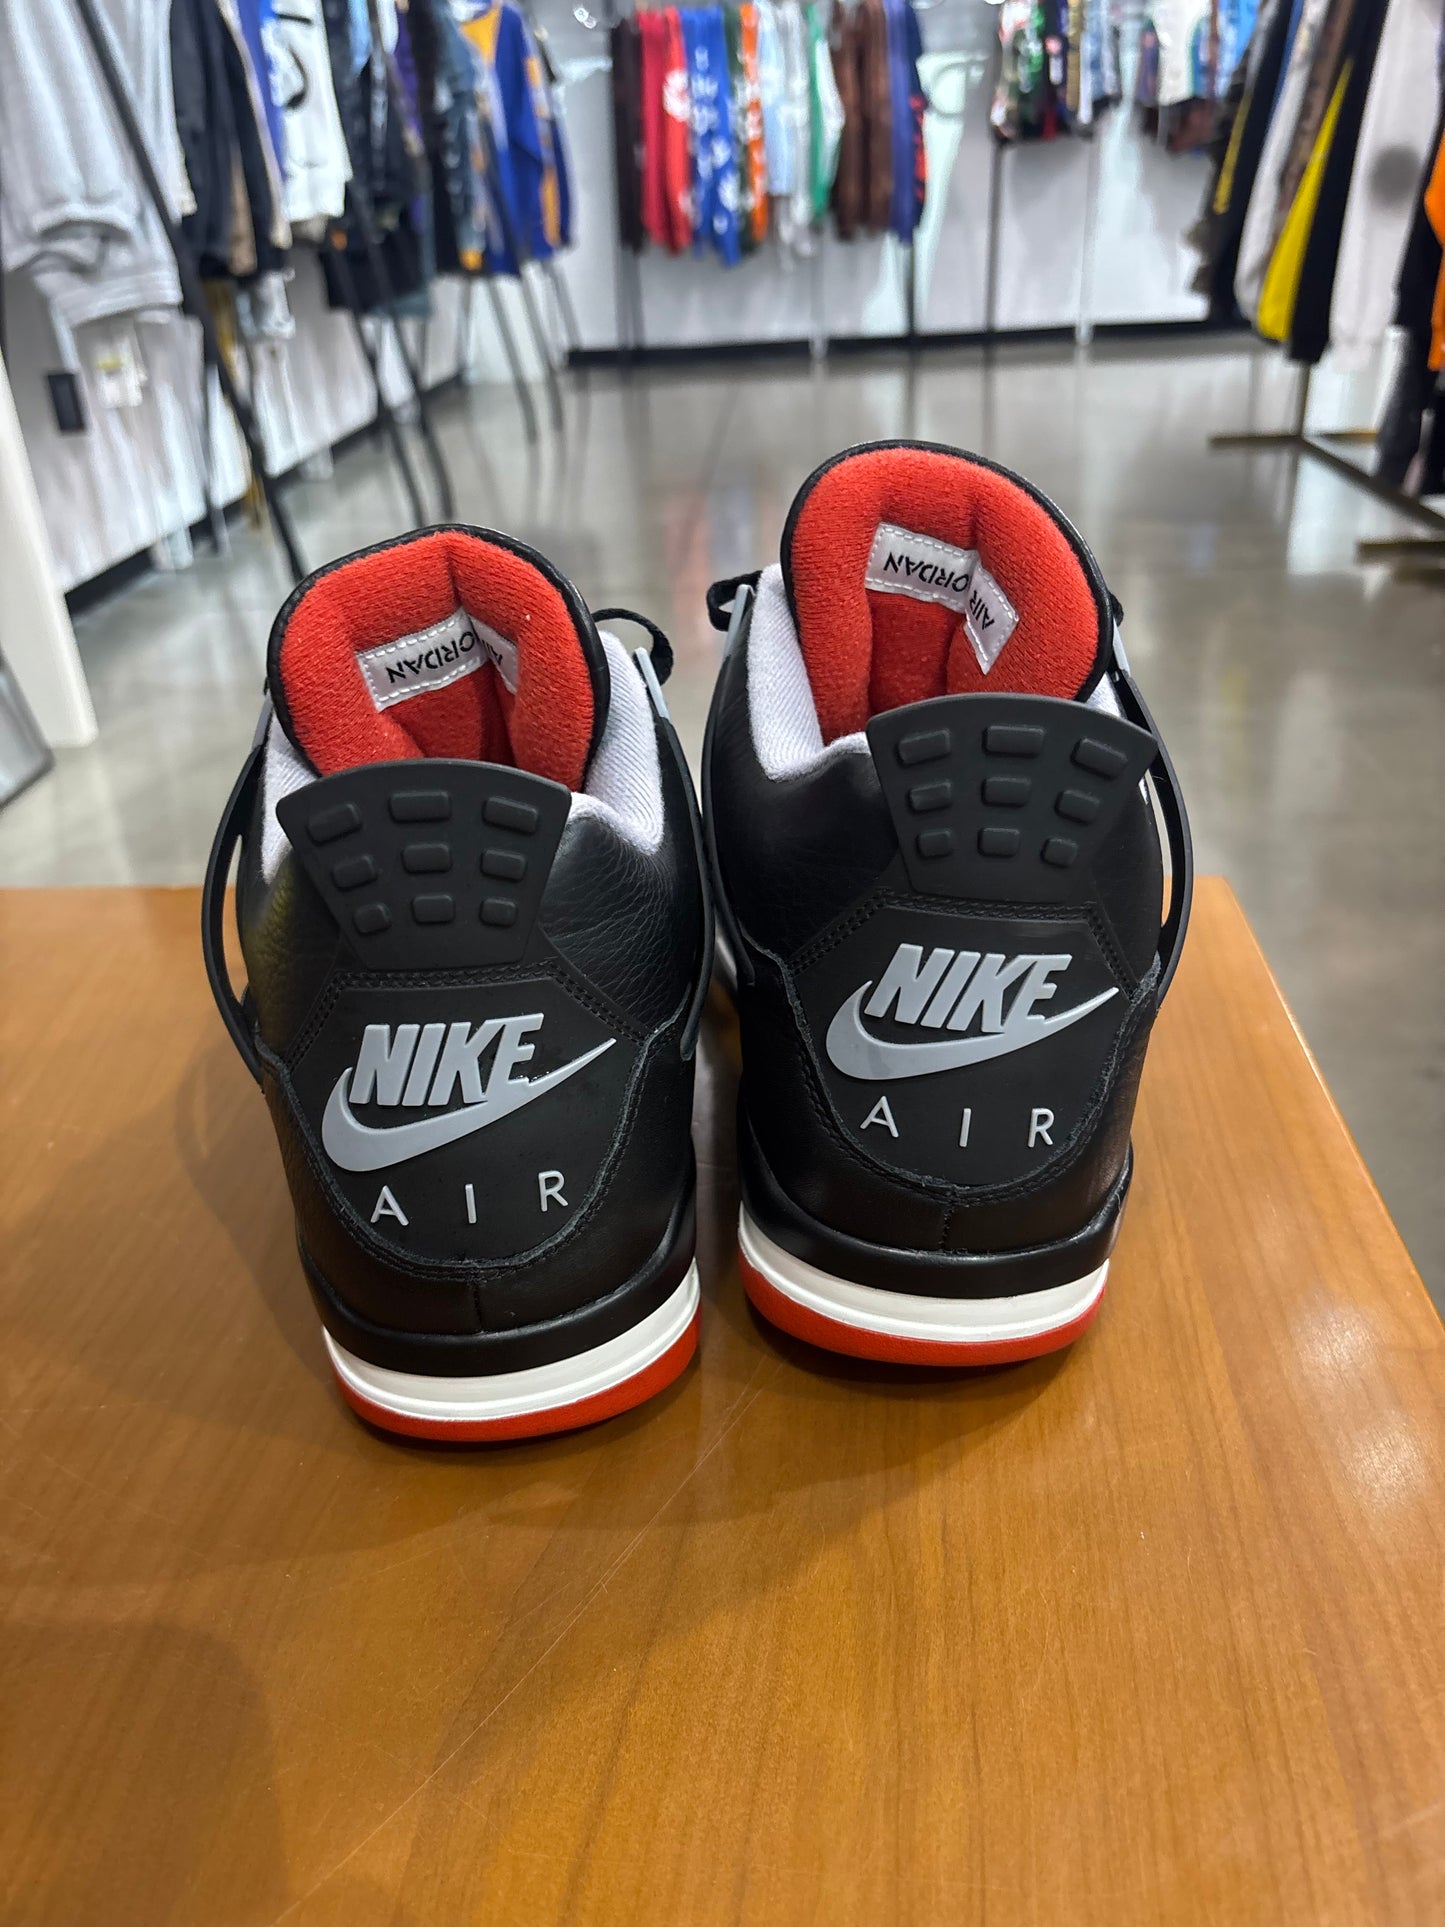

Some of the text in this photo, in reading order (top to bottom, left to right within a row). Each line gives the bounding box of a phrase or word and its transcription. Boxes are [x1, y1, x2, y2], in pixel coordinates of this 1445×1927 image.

[883, 551, 995, 630] AIR ORDAN
[385, 631, 475, 684] ORDAN
[863, 943, 1073, 1034] NIKE
[348, 1012, 545, 1107] NIKE
[859, 1095, 1055, 1149] AIR
[370, 1170, 569, 1227] AIR
